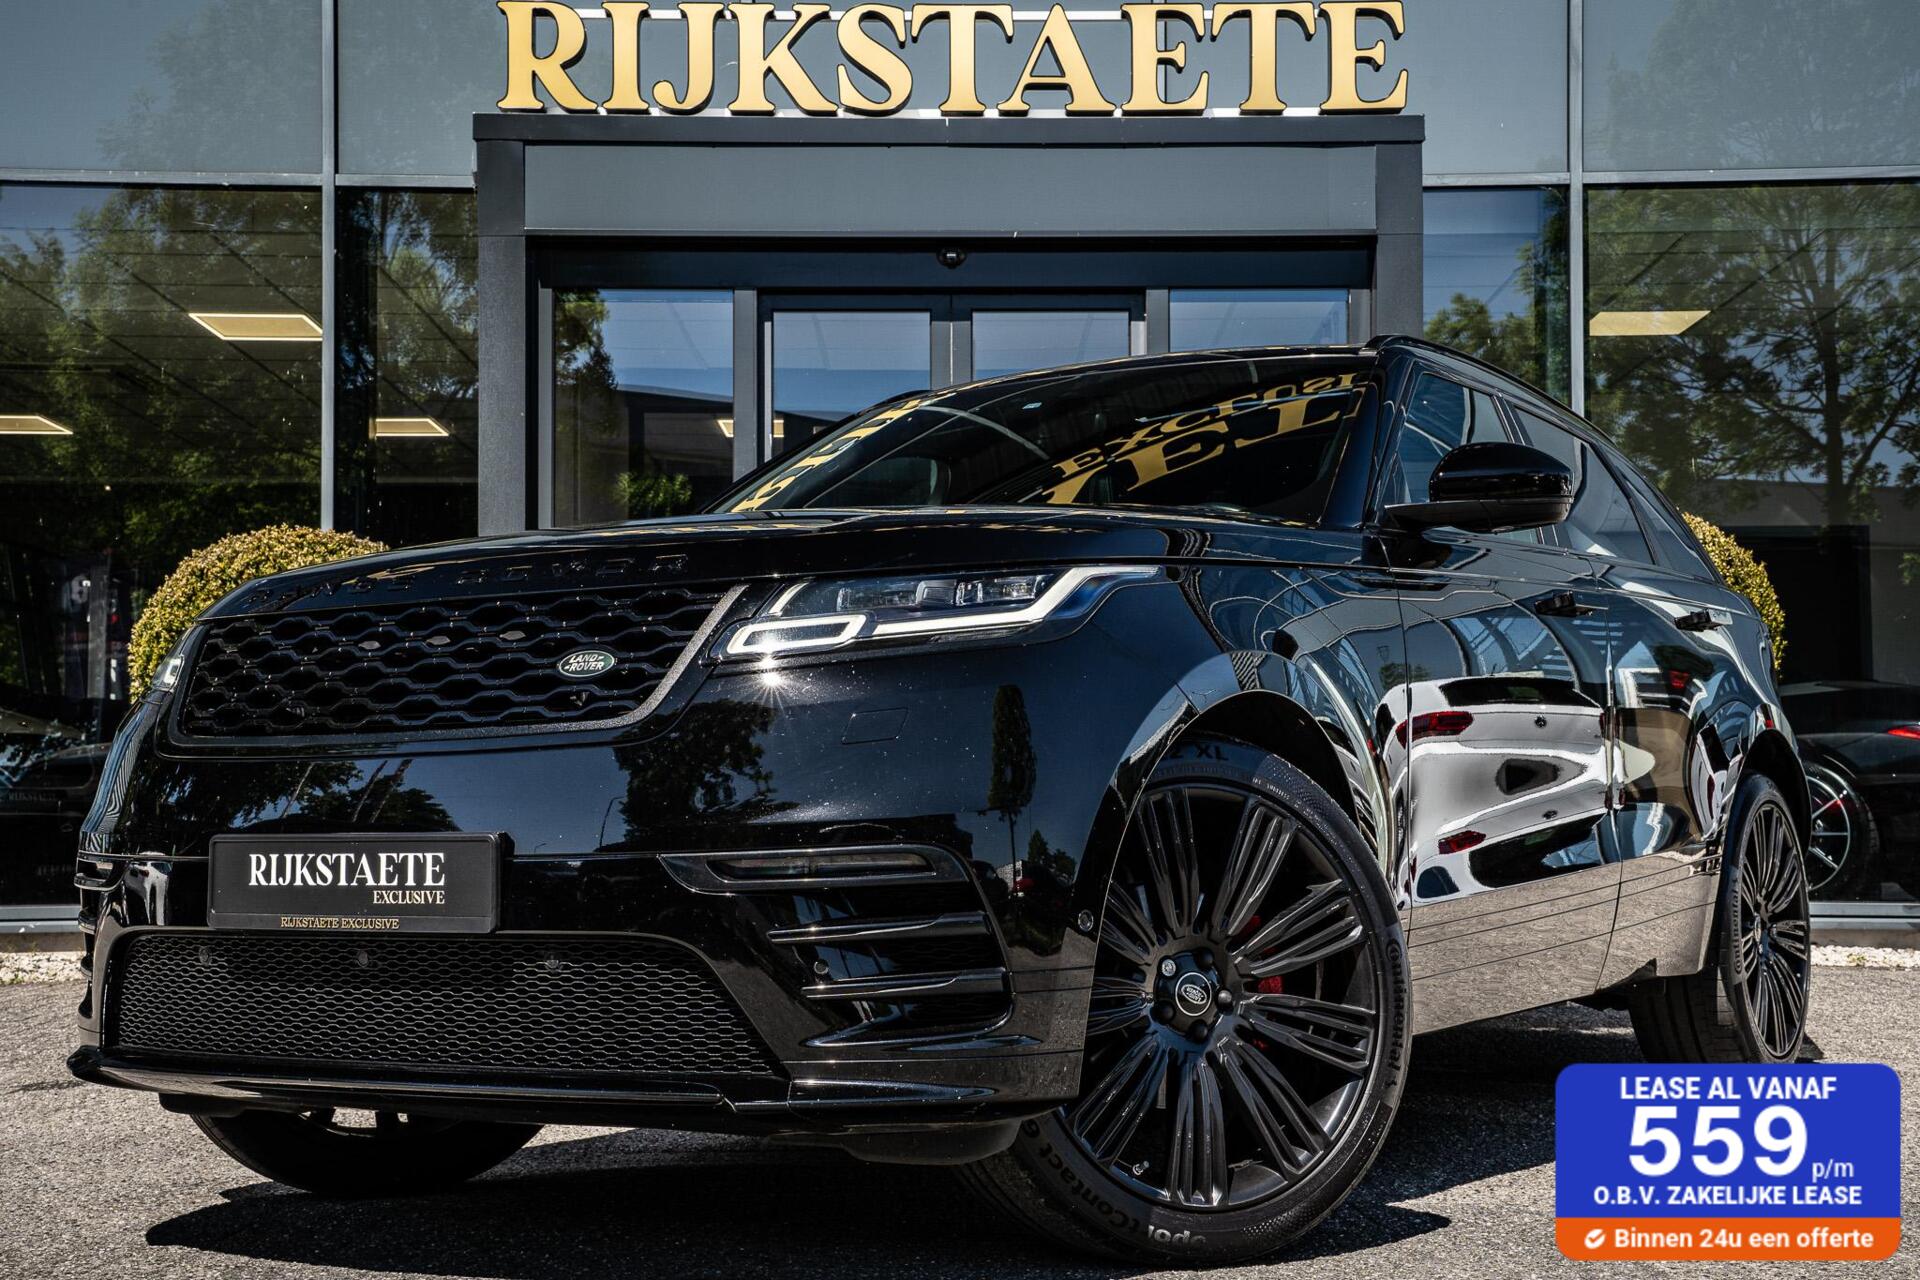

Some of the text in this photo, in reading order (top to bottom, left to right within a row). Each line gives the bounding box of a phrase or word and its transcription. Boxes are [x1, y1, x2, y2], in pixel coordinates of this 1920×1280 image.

[497, 1, 1408, 115] RIJKSTAETE
[569, 654, 598, 663] LAND
[569, 661, 604, 671] ROVER
[249, 852, 445, 886] RIJKSTAETE
[373, 890, 445, 904] EXCLUSIVE
[281, 917, 399, 929] RIJKSTAETE EXCLUSIVE
